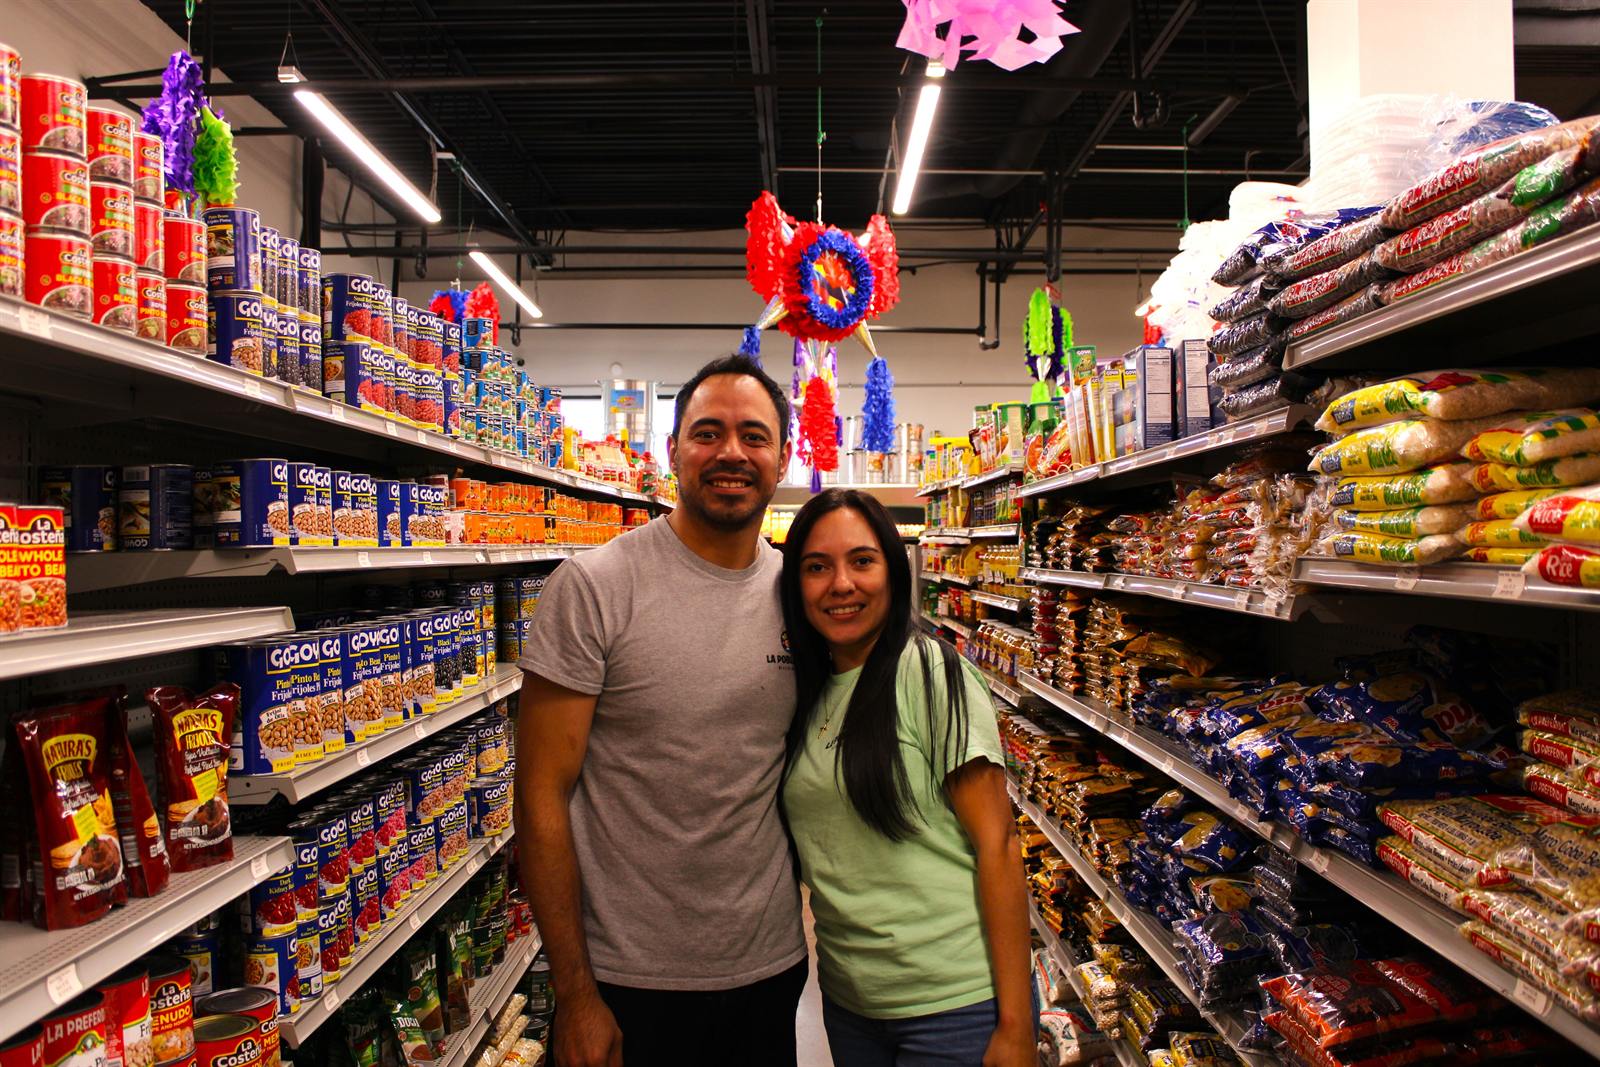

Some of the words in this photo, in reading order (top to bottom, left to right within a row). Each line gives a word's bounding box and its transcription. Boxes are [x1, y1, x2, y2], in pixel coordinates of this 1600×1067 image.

[37, 519, 51, 531] La
[19, 550, 63, 562] WHOLE
[766, 654, 777, 664] LA
[292, 684, 315, 696] rijoles
[162, 985, 176, 996] La
[150, 988, 191, 1011] osteña
[152, 1005, 191, 1027] ENUDO
[47, 1023, 64, 1044] LA
[241, 1041, 253, 1052] La
